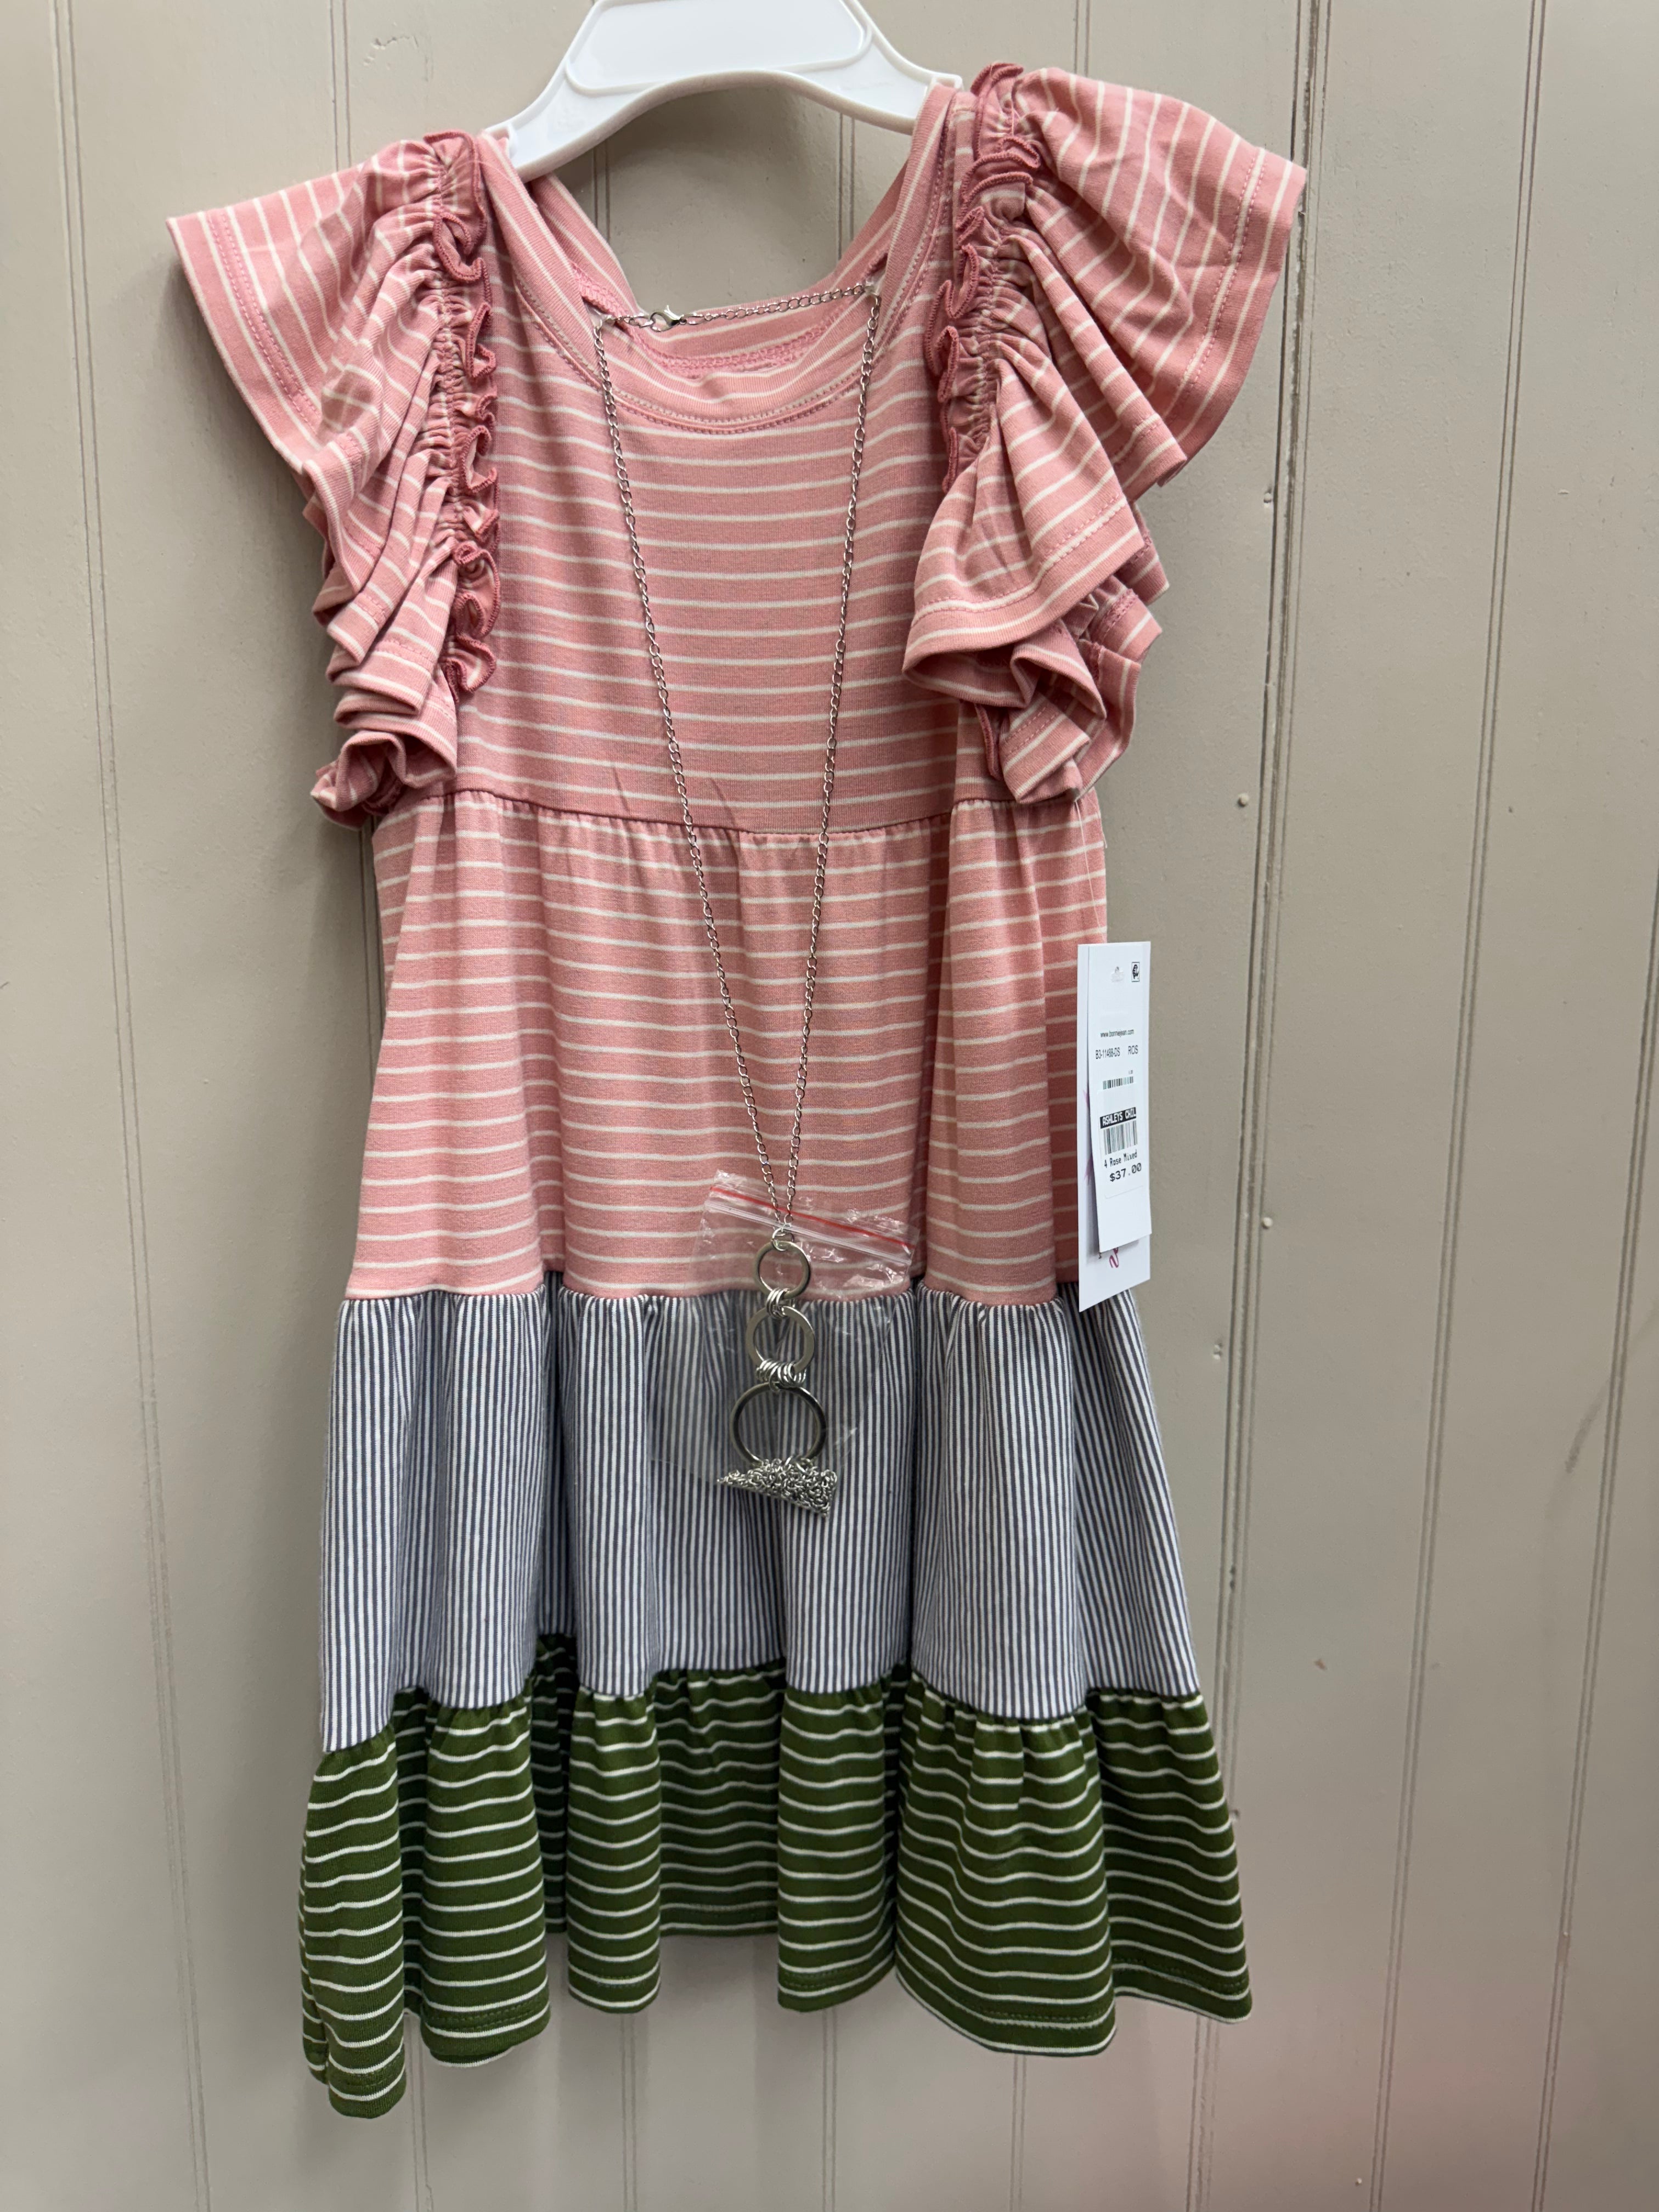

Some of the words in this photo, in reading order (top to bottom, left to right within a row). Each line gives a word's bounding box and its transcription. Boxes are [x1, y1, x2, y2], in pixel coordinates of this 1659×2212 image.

[1128, 1045, 1138, 1055] ROS
[1102, 1112, 1123, 1126] ASHLEYS
[1125, 1108, 1137, 1120] CHIL
[1110, 1157, 1121, 1167] Rose
[1124, 1149, 1137, 1163] Mixed
[1110, 1163, 1142, 1182] $37.00
